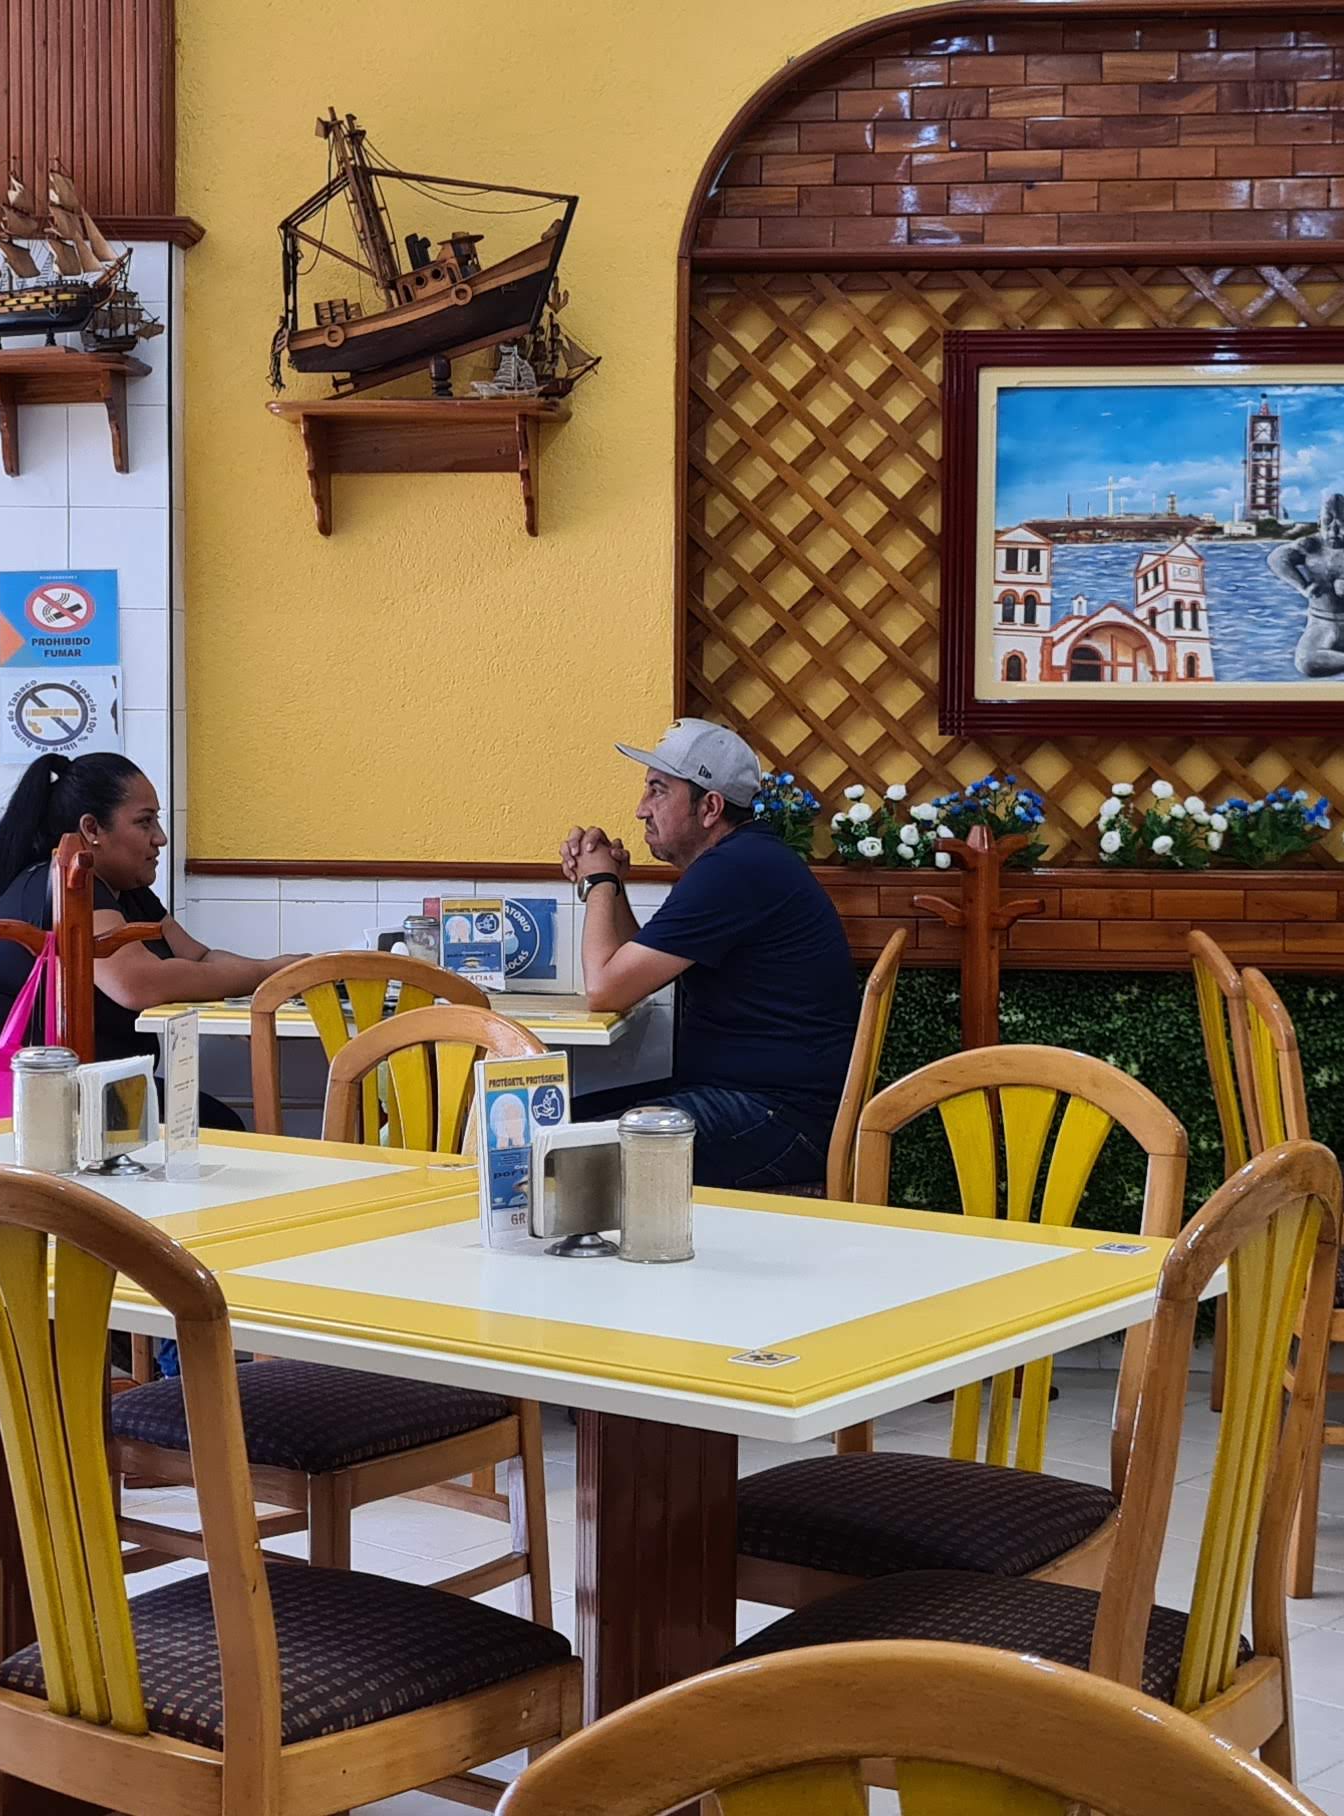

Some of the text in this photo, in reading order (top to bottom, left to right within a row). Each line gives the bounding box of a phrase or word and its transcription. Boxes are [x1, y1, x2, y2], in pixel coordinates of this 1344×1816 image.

[31, 637, 90, 646] PROHIBIDO
[44, 649, 81, 657] FUMAR
[8, 679, 38, 707] Tabaco
[70, 679, 97, 713] Espacio
[7, 710, 15, 722] de
[86, 716, 97, 734] 100
[11, 725, 33, 748] humo
[52, 742, 78, 752] libre
